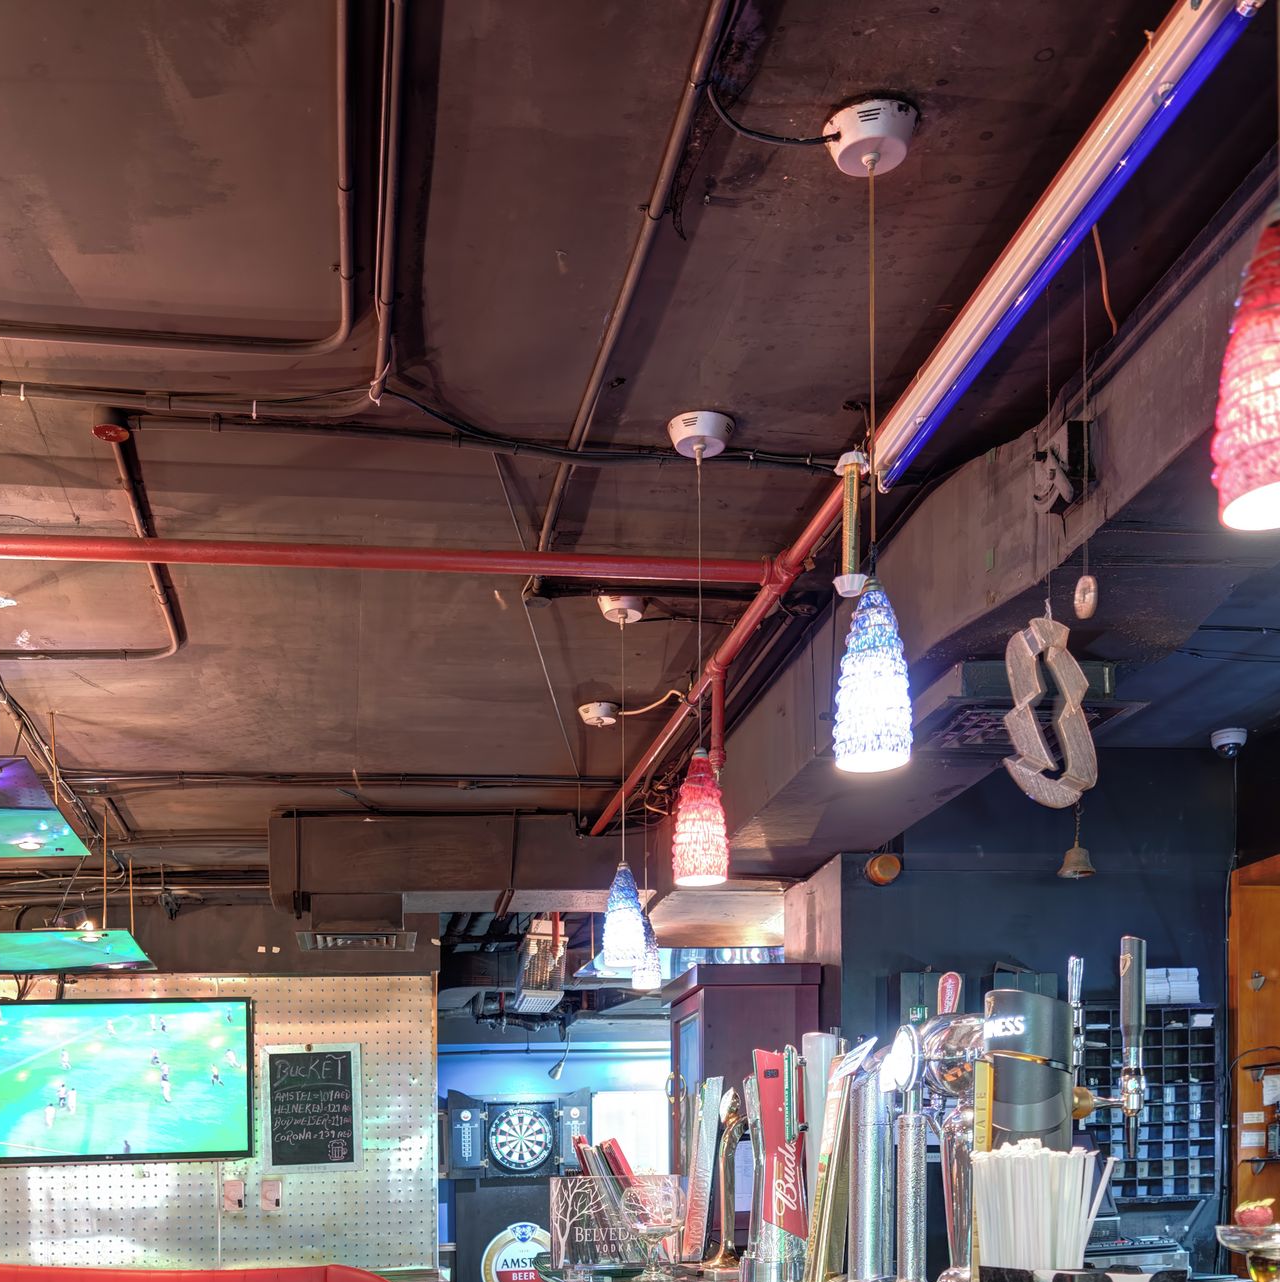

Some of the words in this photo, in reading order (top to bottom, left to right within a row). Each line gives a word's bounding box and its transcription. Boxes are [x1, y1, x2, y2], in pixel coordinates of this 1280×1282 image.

[984, 1017, 1025, 1039] NESS
[690, 1166, 711, 1256] STRONGBOW
[596, 1244, 633, 1253] VODKA
[501, 1258, 535, 1269] AMST
[512, 1272, 536, 1281] BEER
